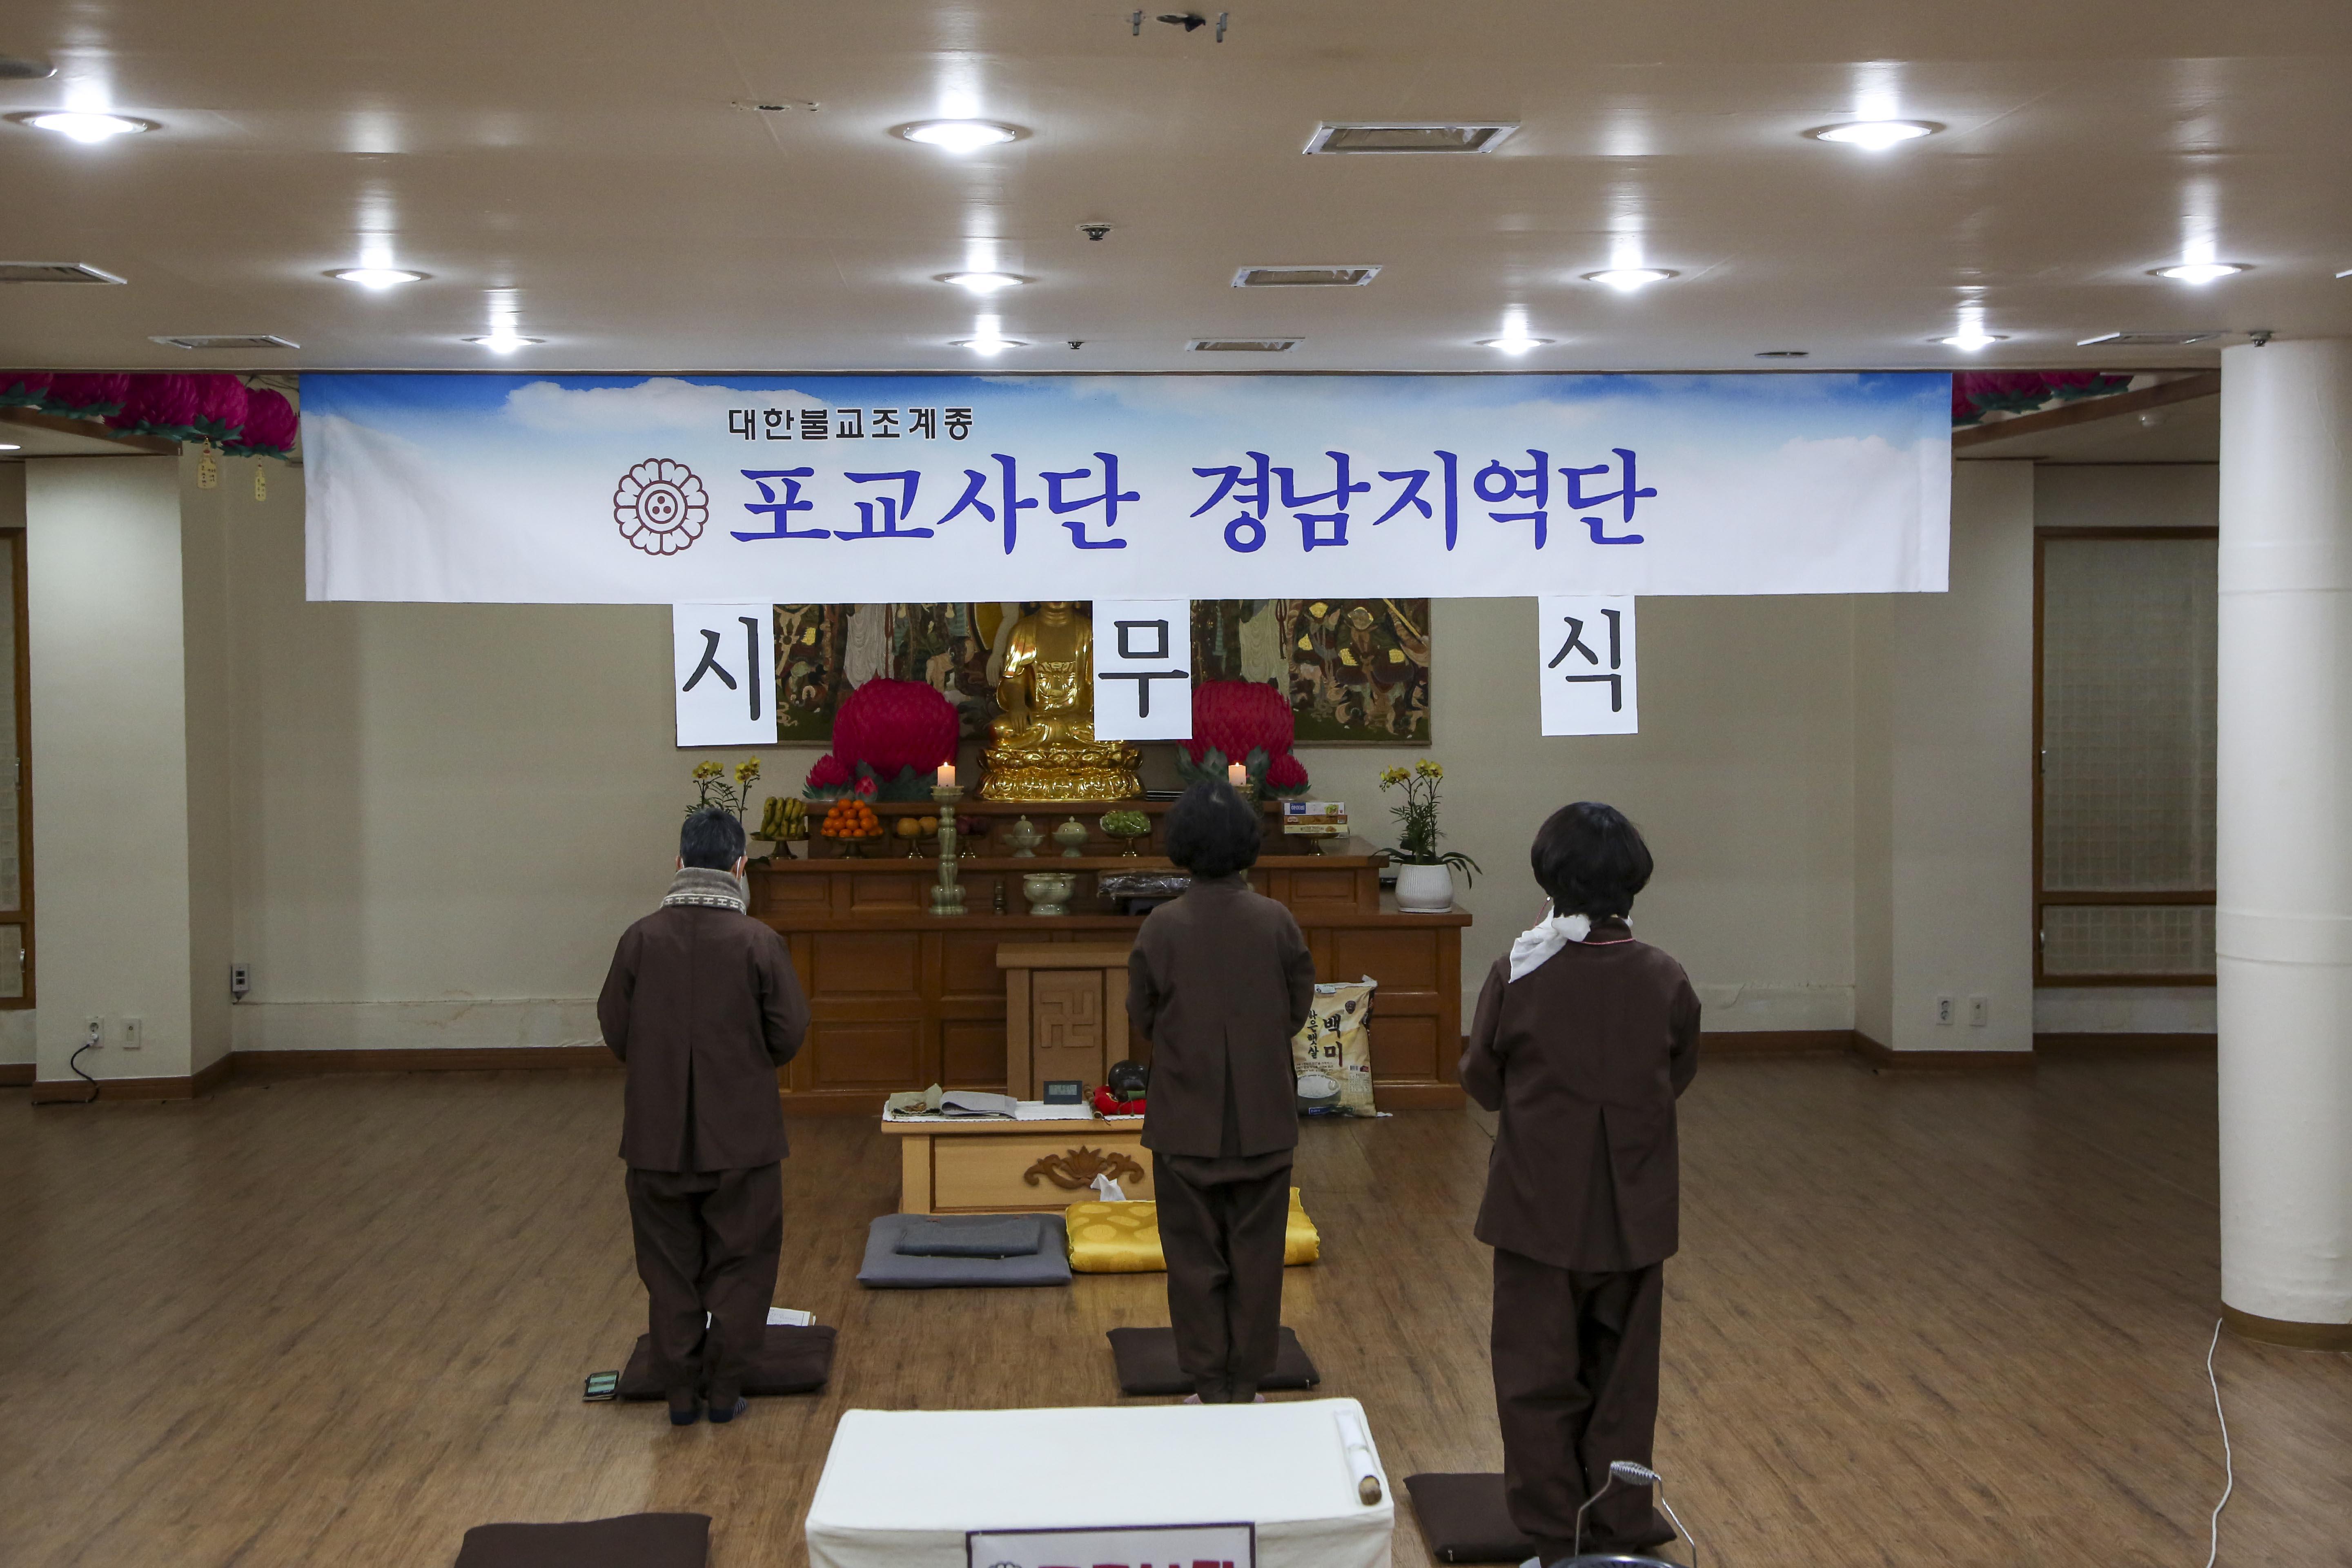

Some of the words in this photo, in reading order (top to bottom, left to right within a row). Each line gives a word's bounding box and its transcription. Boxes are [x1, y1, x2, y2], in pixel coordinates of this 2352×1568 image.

[729, 408, 972, 440] 대한불교조계종
[730, 452, 1140, 555] 포교사단
[1190, 448, 1658, 553] 경남지역단
[682, 617, 760, 721] 시
[1098, 619, 1189, 718] 무
[1548, 609, 1622, 712] 식
[1323, 1013, 1343, 1067] 백미
